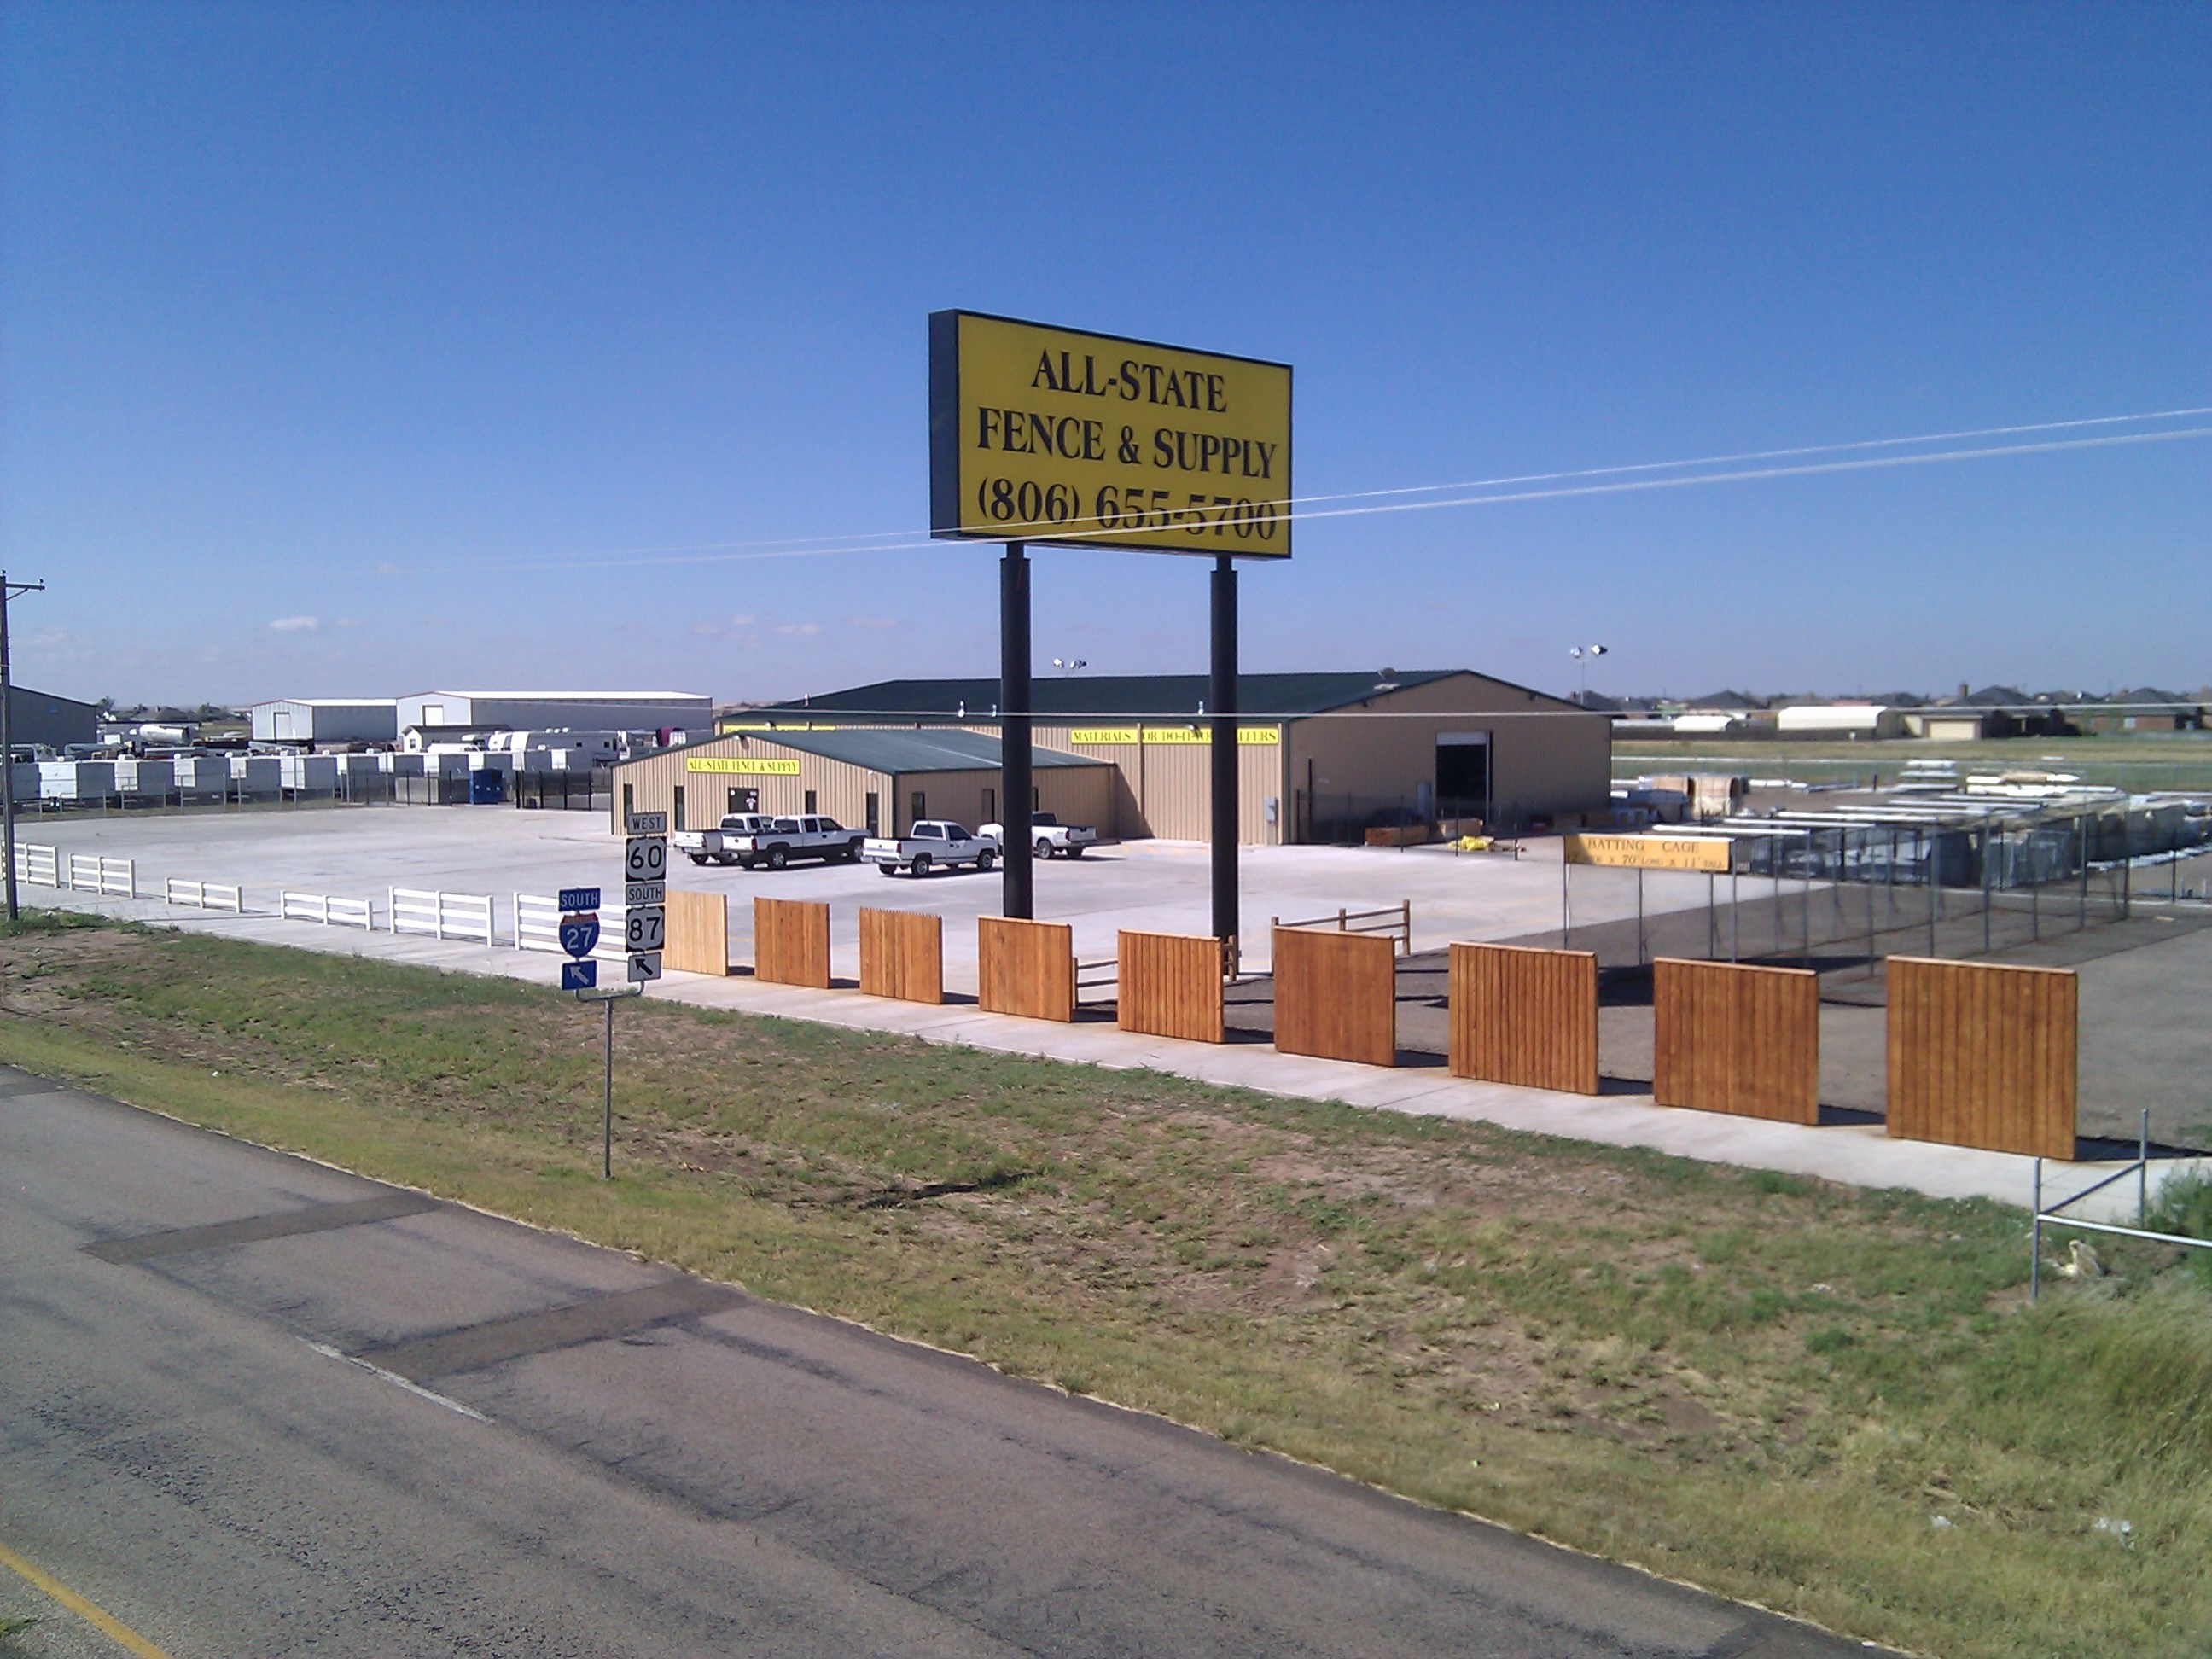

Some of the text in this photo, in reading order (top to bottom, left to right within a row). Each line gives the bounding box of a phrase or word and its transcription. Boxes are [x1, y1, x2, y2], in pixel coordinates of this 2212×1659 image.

[1031, 348, 1227, 413] ALL-STATE
[978, 406, 1278, 480] FENCE & SUPPLY
[978, 476, 1278, 540] (806) 655-5700
[1074, 731, 1132, 742] MATERIALS
[1138, 731, 1157, 742] OR
[690, 760, 797, 772] ALL-STATE FENCE & SUPPLY
[632, 816, 661, 830] WEST
[1588, 838, 1699, 853] BATTING CAGE
[629, 844, 662, 870] 60
[560, 892, 598, 908] SOUTH
[628, 886, 662, 901] SOUTH
[566, 926, 593, 950] 27
[628, 916, 661, 942] 87
